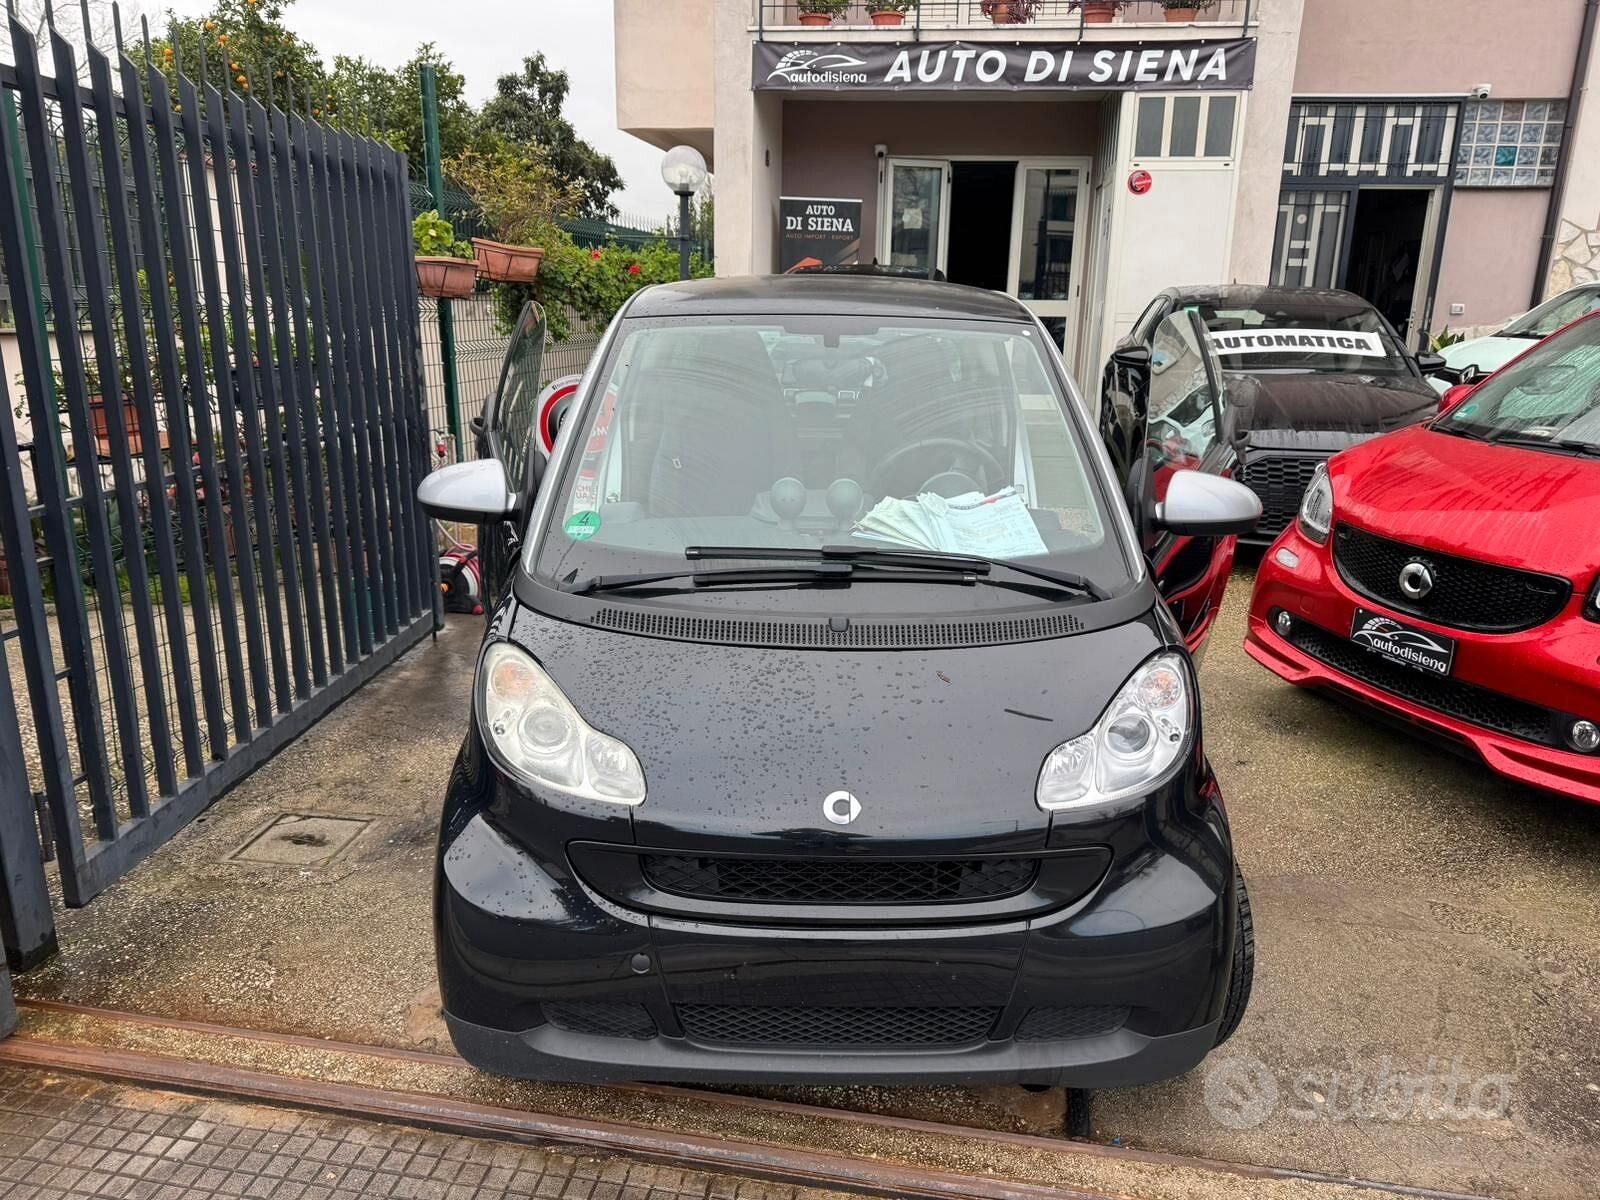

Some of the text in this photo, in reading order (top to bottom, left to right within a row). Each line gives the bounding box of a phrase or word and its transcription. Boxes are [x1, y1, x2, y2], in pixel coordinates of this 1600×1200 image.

[883, 48, 1227, 83] AUTO DI SIENA
[790, 72, 867, 84] autodisiena
[805, 204, 836, 216] AUTO
[785, 216, 854, 232] DI SIENA
[1211, 335, 1373, 351] AUTOMATICA
[579, 511, 591, 526] 4
[1373, 638, 1447, 672] autodisiena
